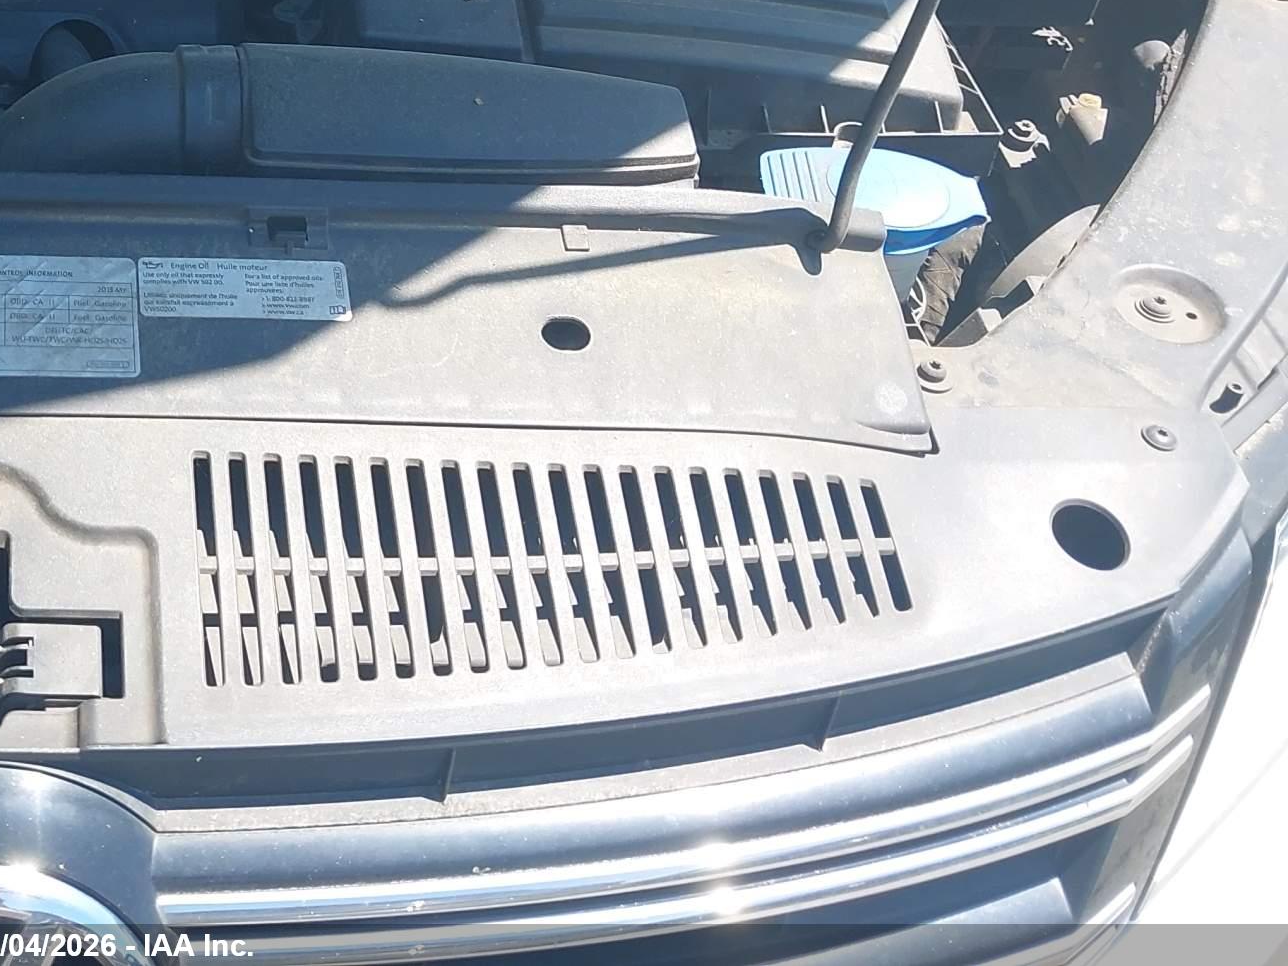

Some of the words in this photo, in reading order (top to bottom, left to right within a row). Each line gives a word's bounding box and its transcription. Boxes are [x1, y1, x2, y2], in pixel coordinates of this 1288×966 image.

[170, 262, 197, 271] Engine
[26, 269, 73, 277] INFORMATION
[280, 274, 311, 282] approved
